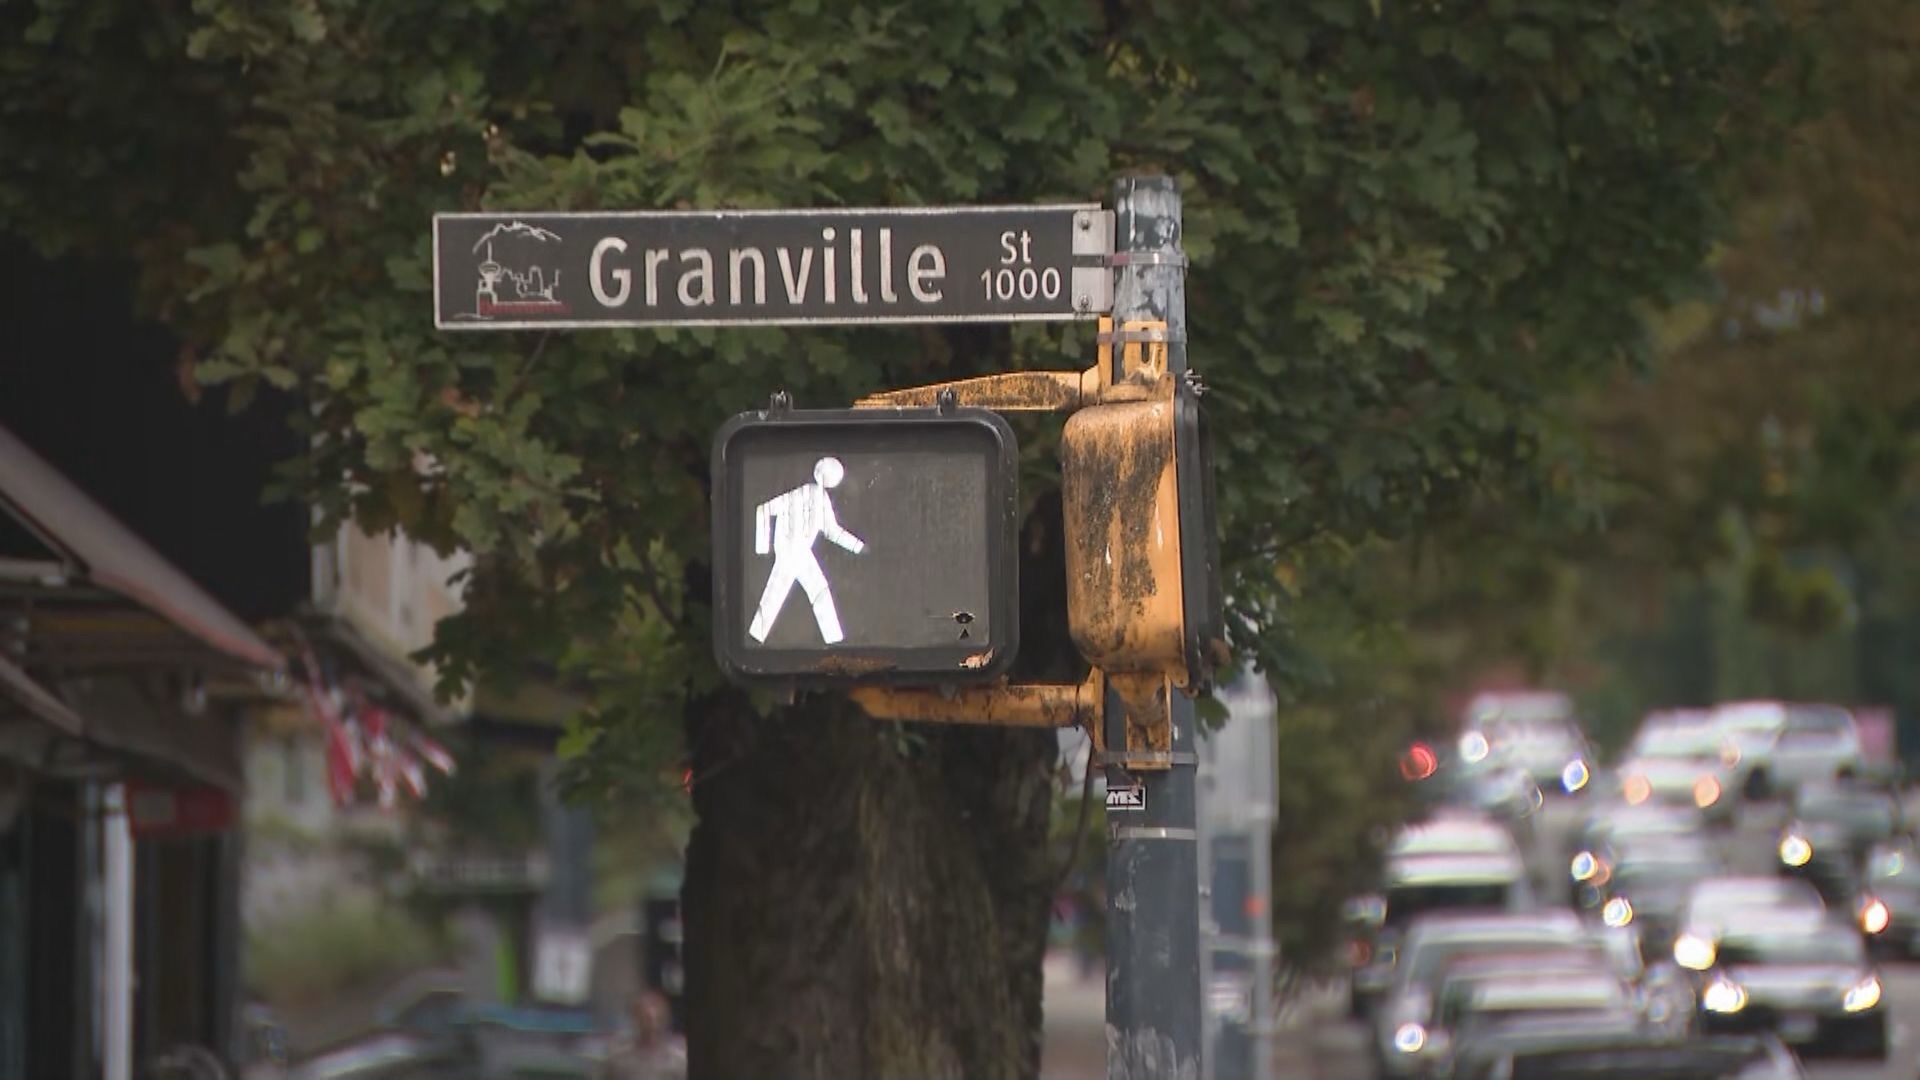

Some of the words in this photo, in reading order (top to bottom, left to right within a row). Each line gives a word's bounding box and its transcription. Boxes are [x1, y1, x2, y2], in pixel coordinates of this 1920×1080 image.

[589, 226, 946, 308] Granville
[1000, 229, 1033, 266] St
[980, 267, 1061, 301] 1000
